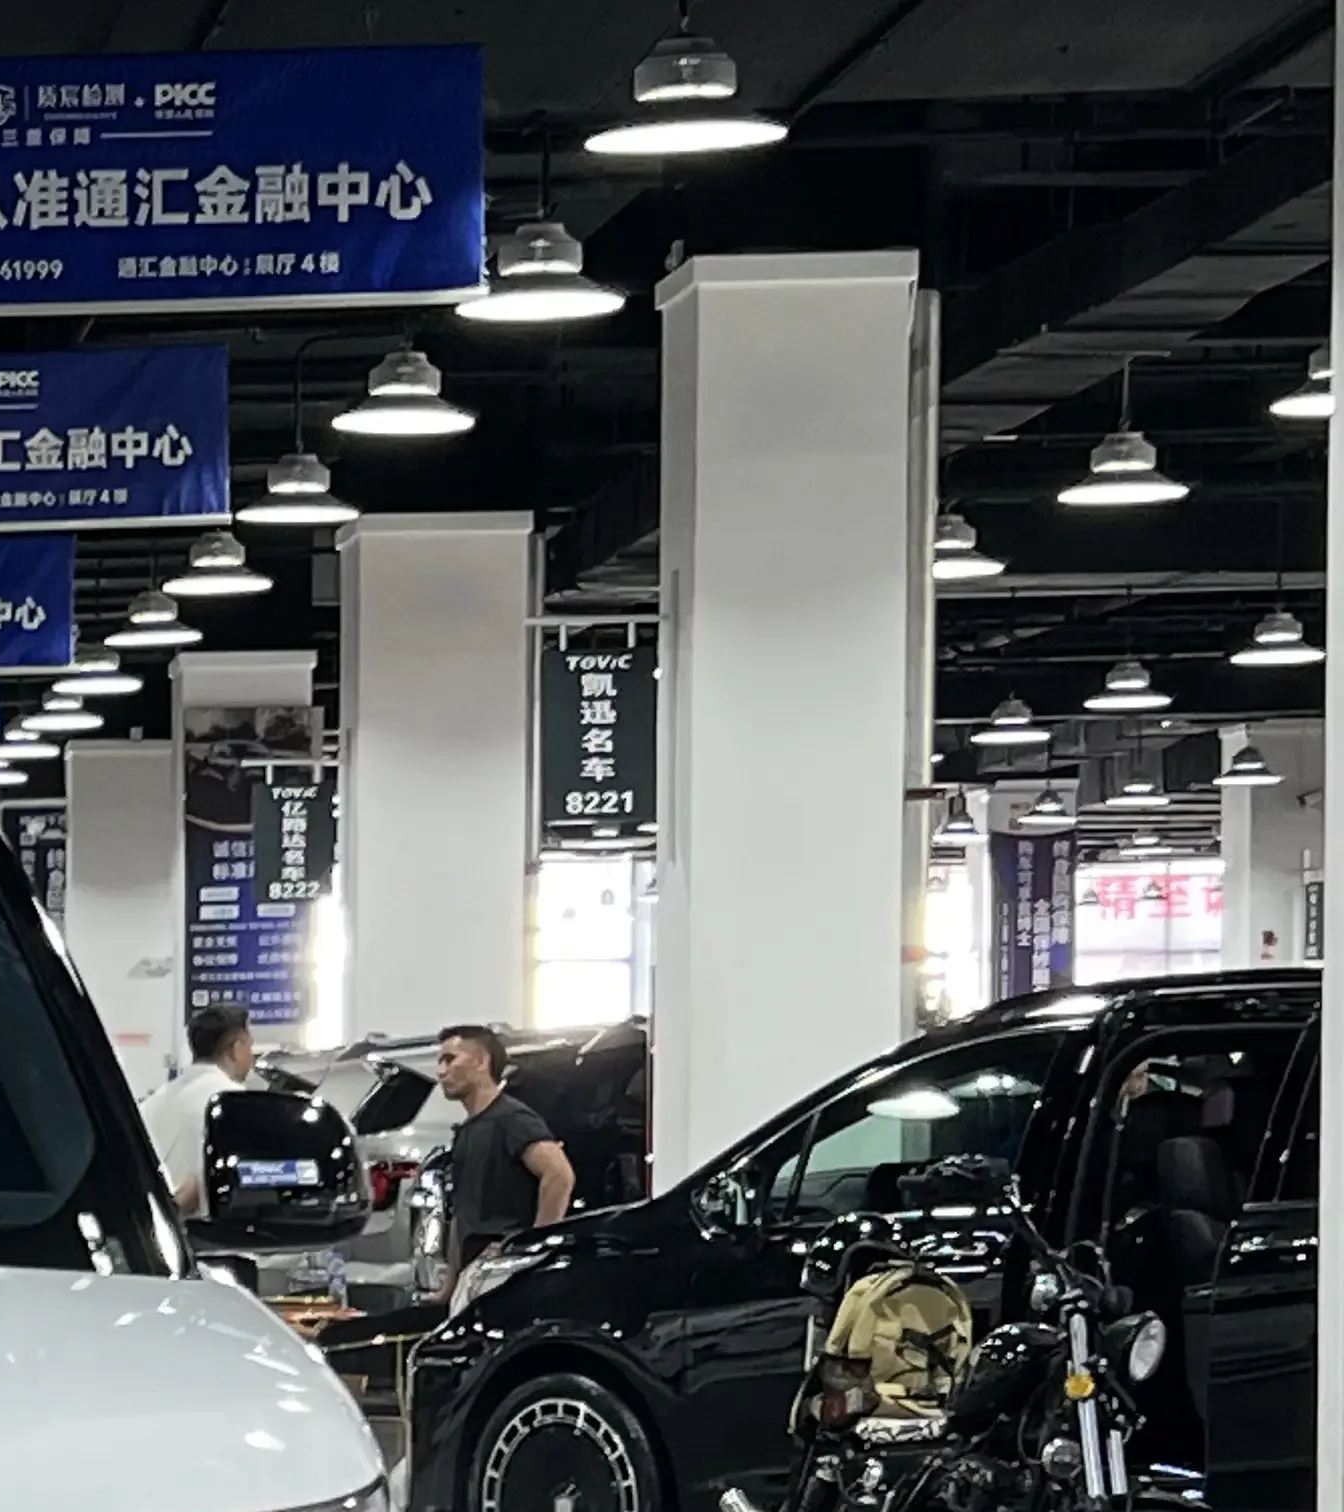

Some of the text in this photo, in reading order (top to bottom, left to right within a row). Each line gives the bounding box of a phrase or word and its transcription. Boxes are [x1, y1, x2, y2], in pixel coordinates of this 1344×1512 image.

[154, 82, 216, 107] PICC
[565, 654, 633, 672] TOVIC
[271, 786, 319, 800] TOVIC
[564, 789, 634, 815] 8221
[268, 880, 321, 900] 8222
